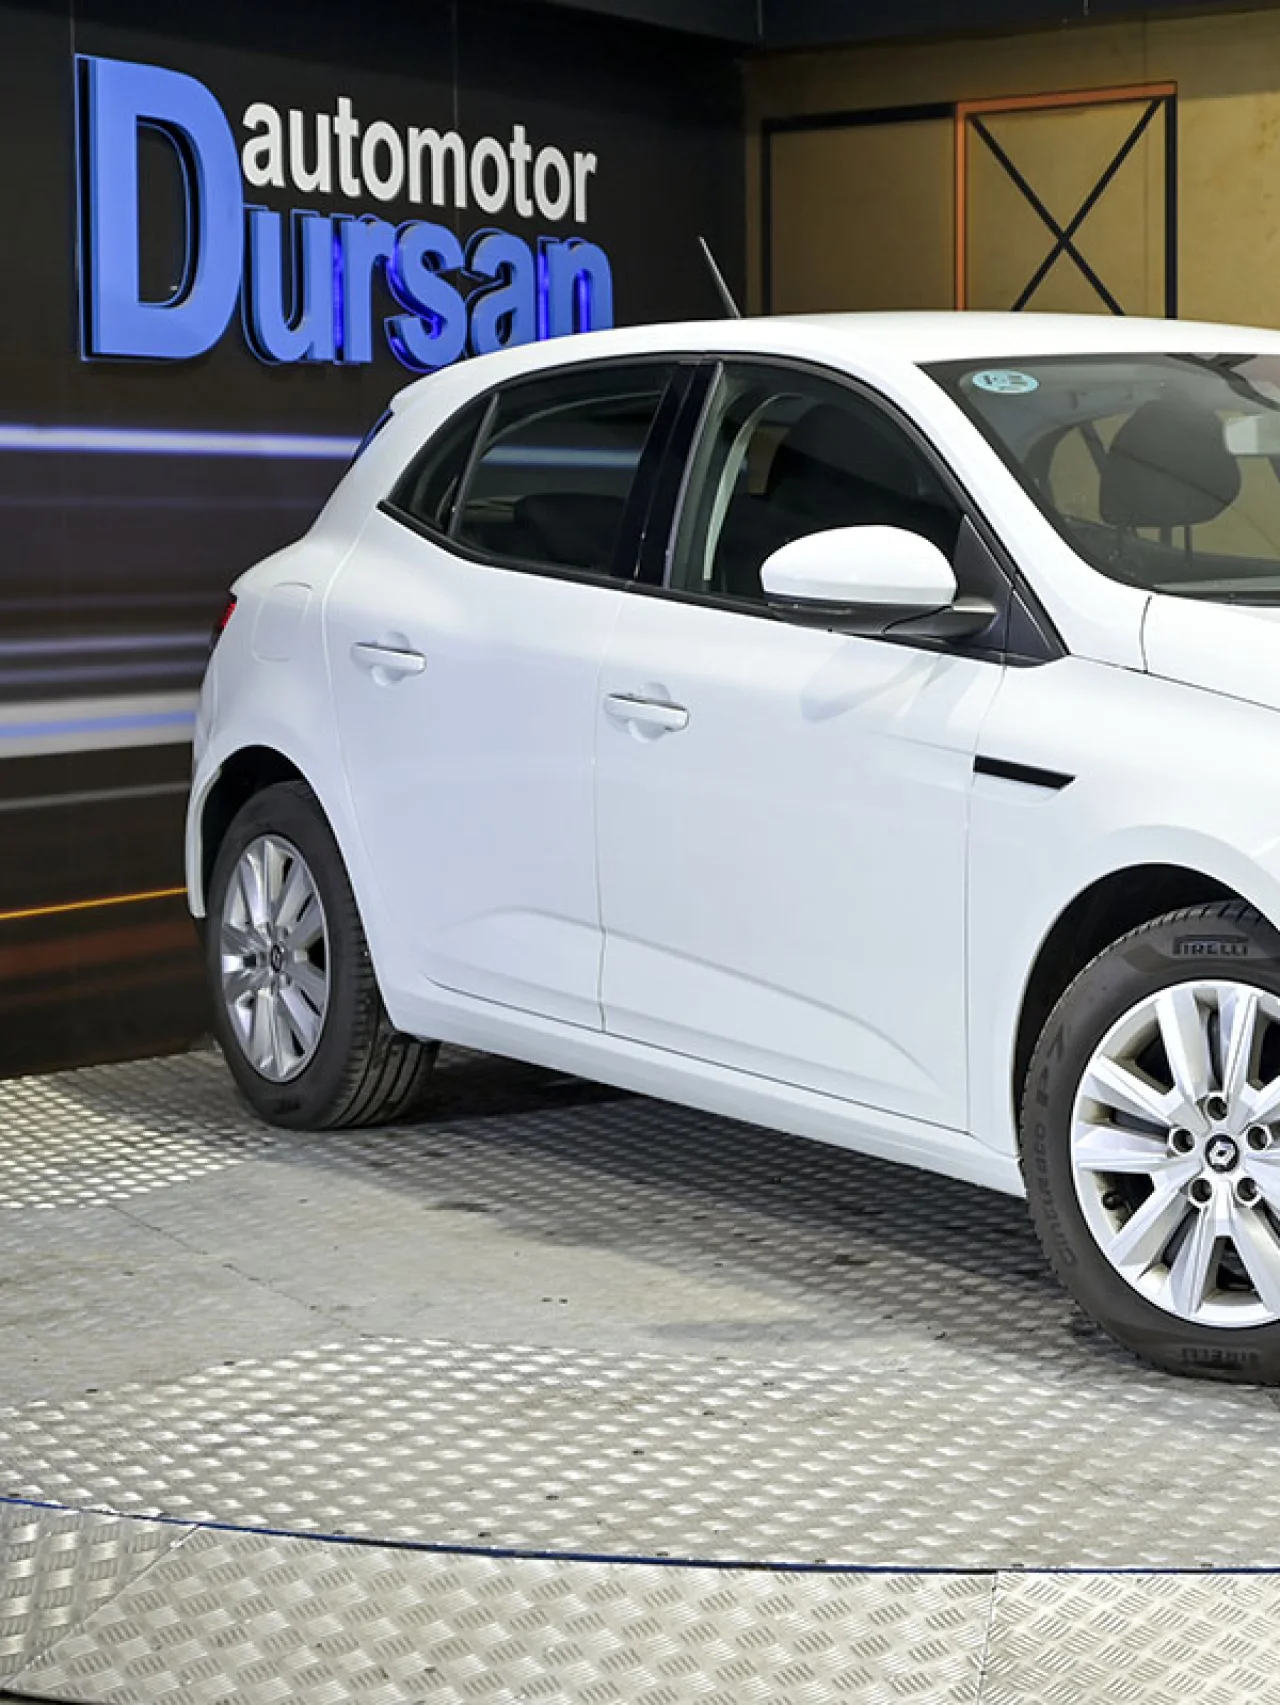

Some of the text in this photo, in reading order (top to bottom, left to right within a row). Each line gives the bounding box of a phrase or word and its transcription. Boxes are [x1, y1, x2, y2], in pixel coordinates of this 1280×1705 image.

[75, 53, 614, 373] Dursan
[242, 96, 598, 223] automotor
[1173, 934, 1249, 957] PIRELLI
